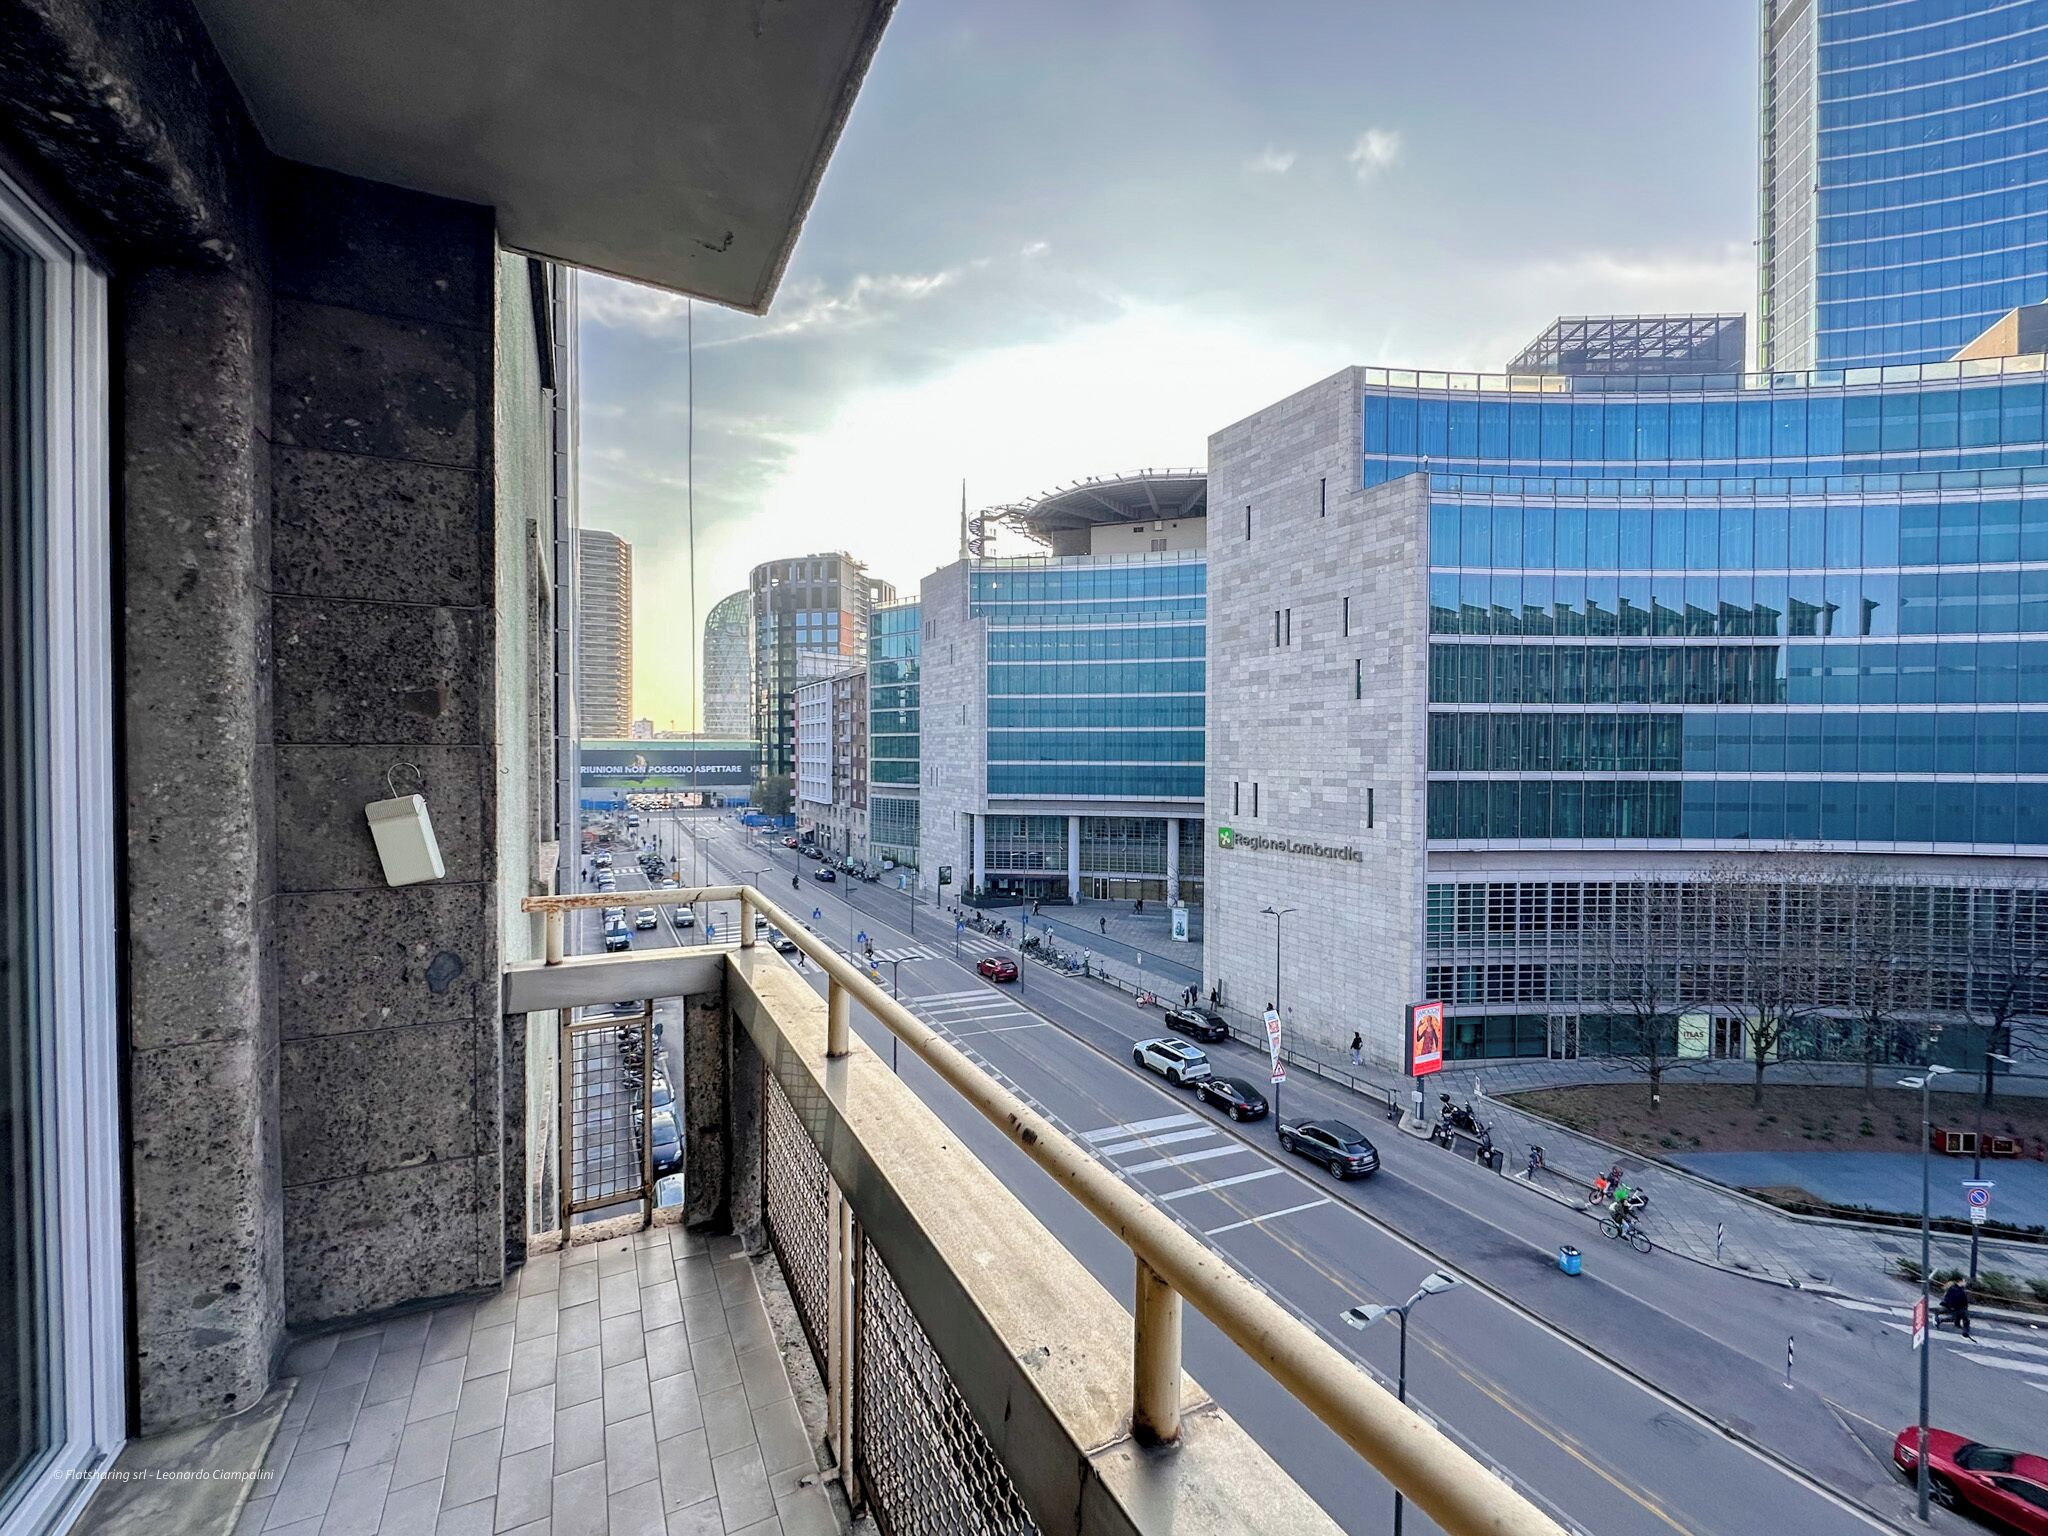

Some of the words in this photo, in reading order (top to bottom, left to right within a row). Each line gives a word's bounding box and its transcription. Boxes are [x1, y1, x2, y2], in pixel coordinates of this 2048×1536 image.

[580, 765, 623, 774] RIUNIONI
[625, 765, 646, 774] NON
[649, 765, 693, 774] POSSONO
[694, 765, 742, 773] ASPETTARE
